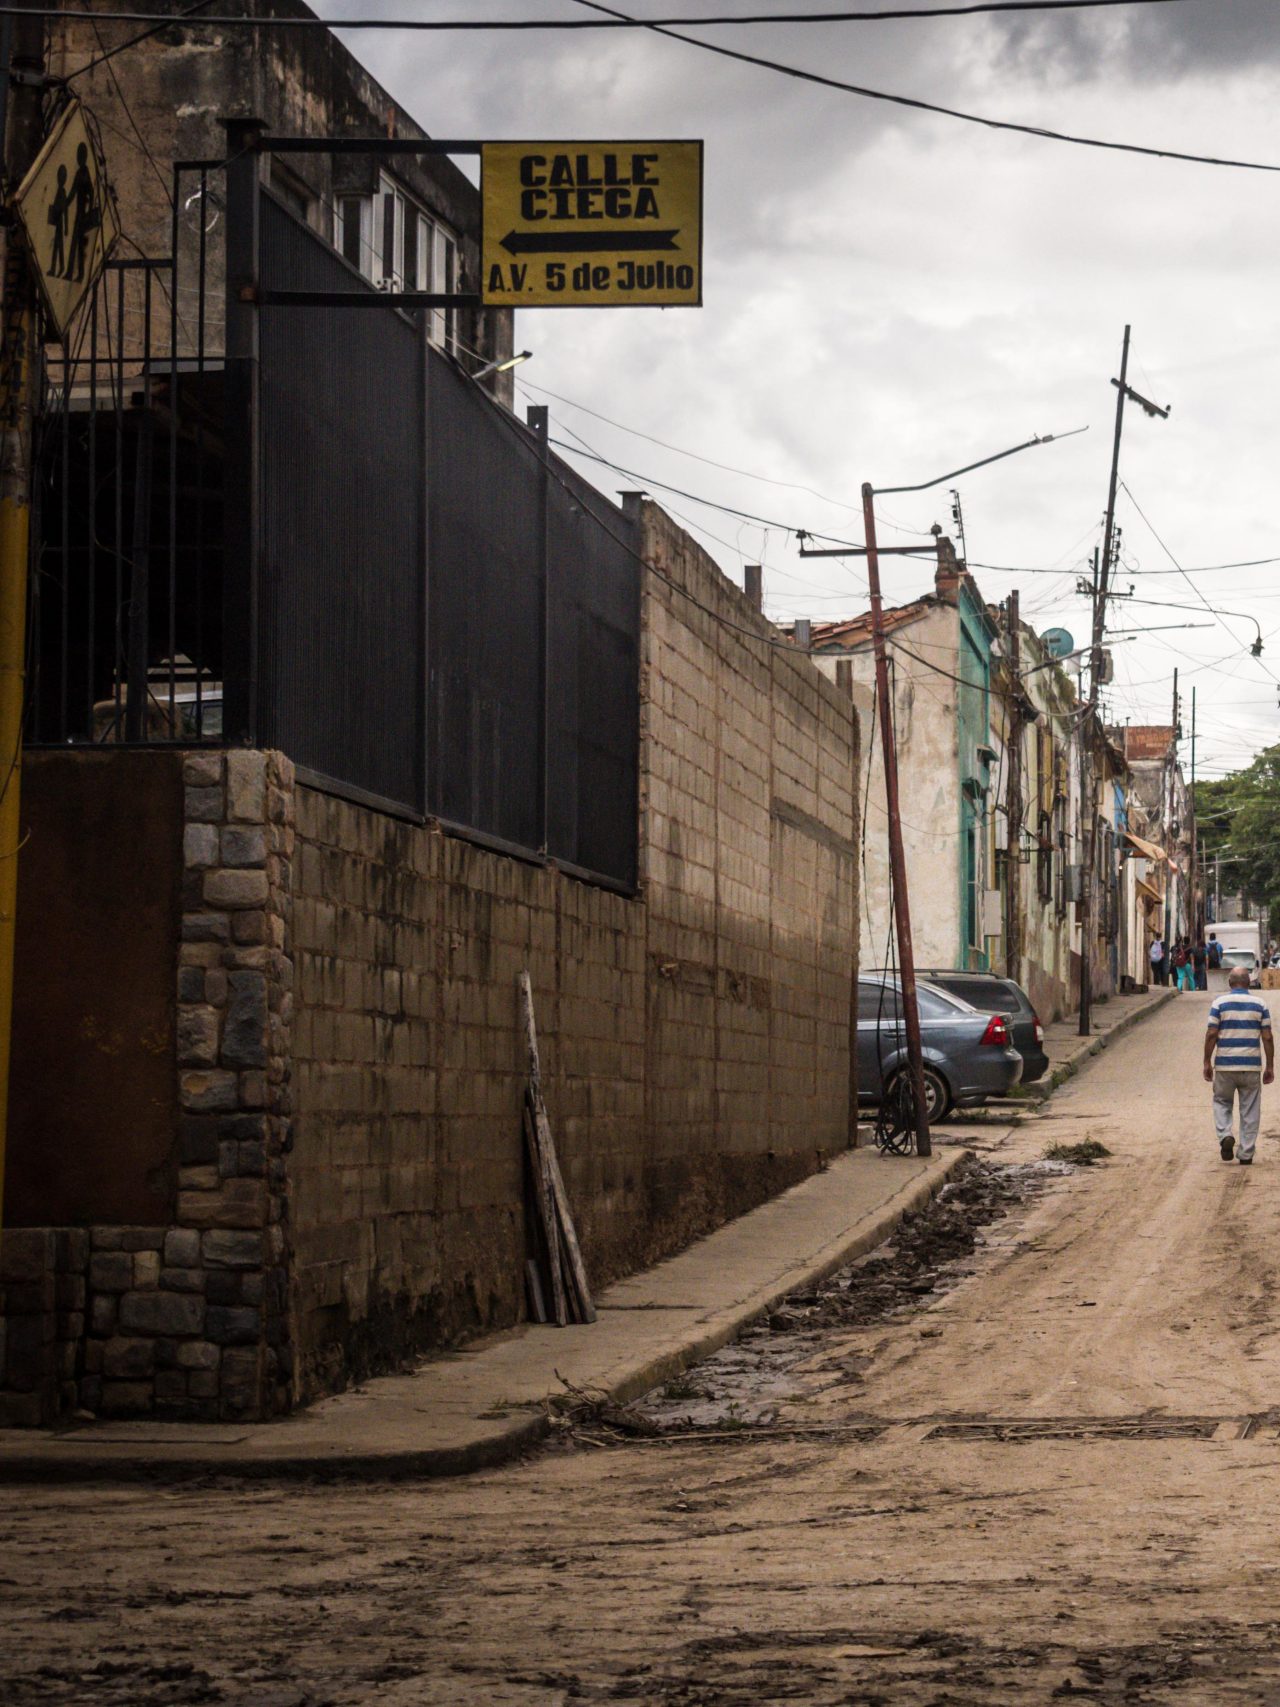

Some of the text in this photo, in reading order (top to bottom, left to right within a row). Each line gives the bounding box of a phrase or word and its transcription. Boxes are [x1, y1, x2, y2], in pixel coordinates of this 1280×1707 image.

[520, 154, 659, 187] CALLE
[521, 188, 660, 221] CIEGA
[546, 263, 566, 291] 5
[572, 262, 610, 291] de
[617, 261, 693, 290] Julio
